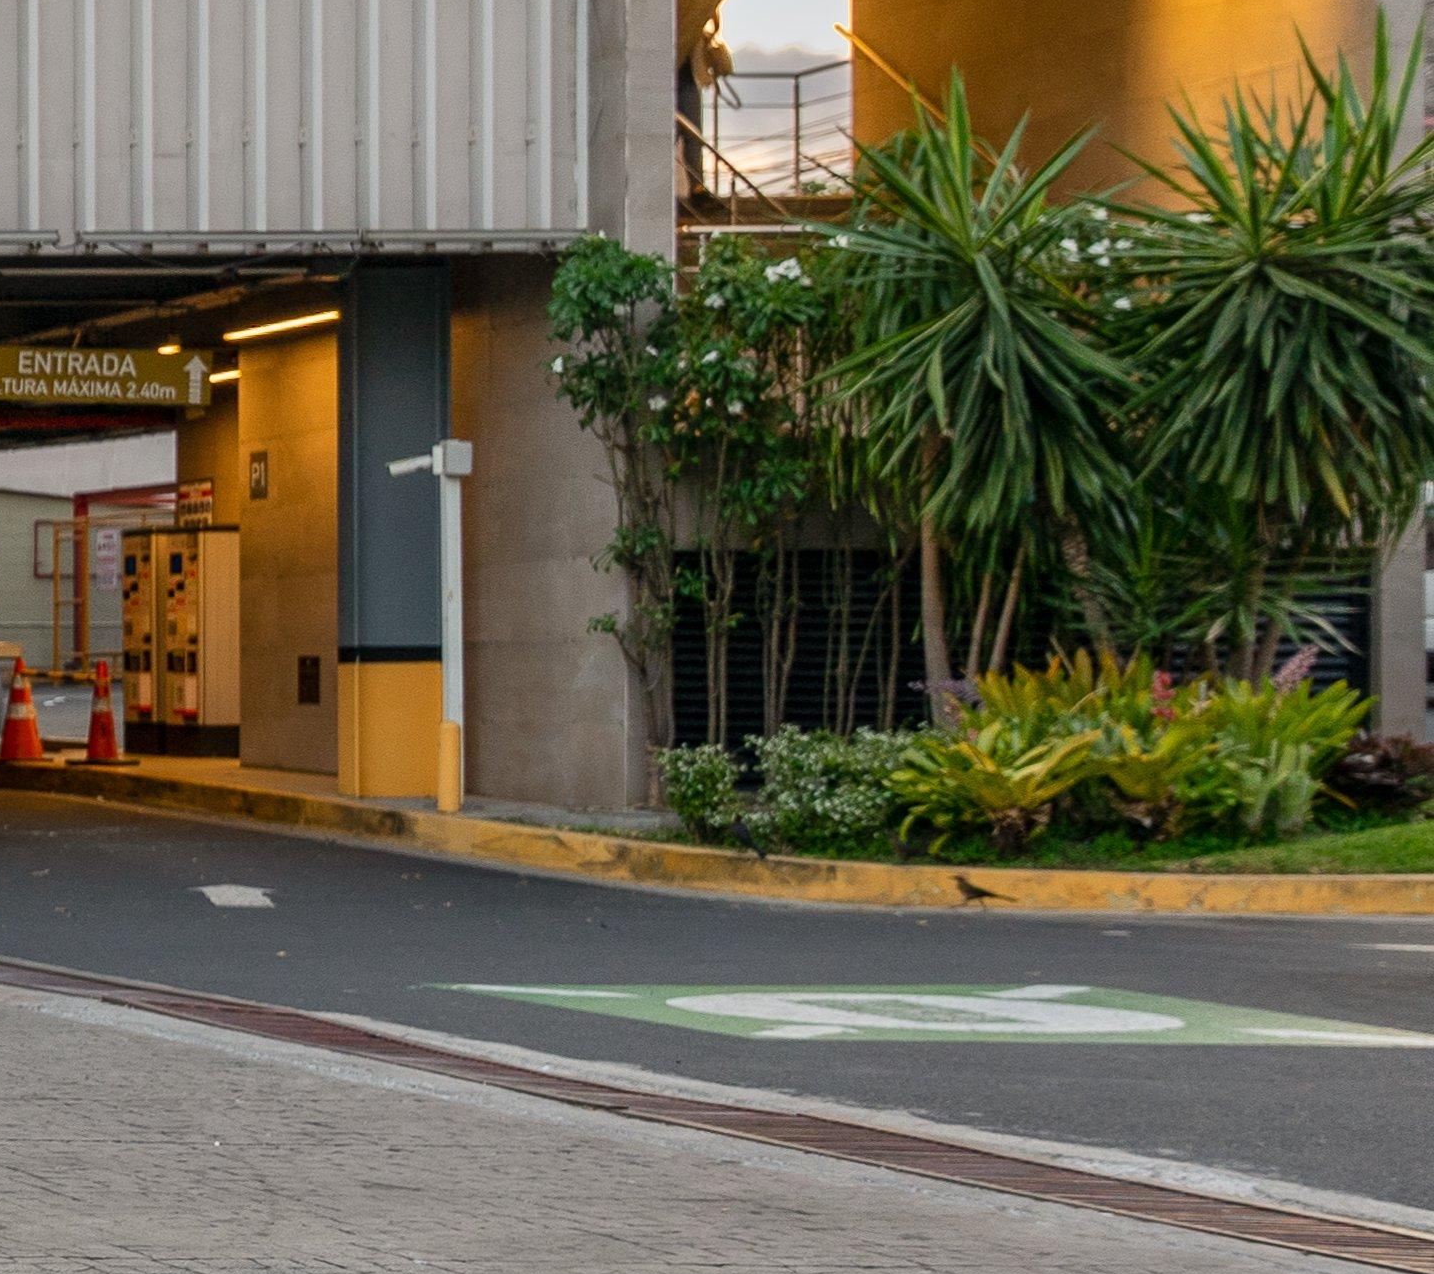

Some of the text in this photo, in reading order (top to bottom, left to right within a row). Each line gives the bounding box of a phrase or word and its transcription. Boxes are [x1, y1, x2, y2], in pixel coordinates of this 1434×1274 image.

[18, 350, 137, 377] ENTRADA
[53, 377, 121, 398] MÁXIMA
[126, 381, 177, 401] 2.40m
[252, 461, 265, 488] P1
